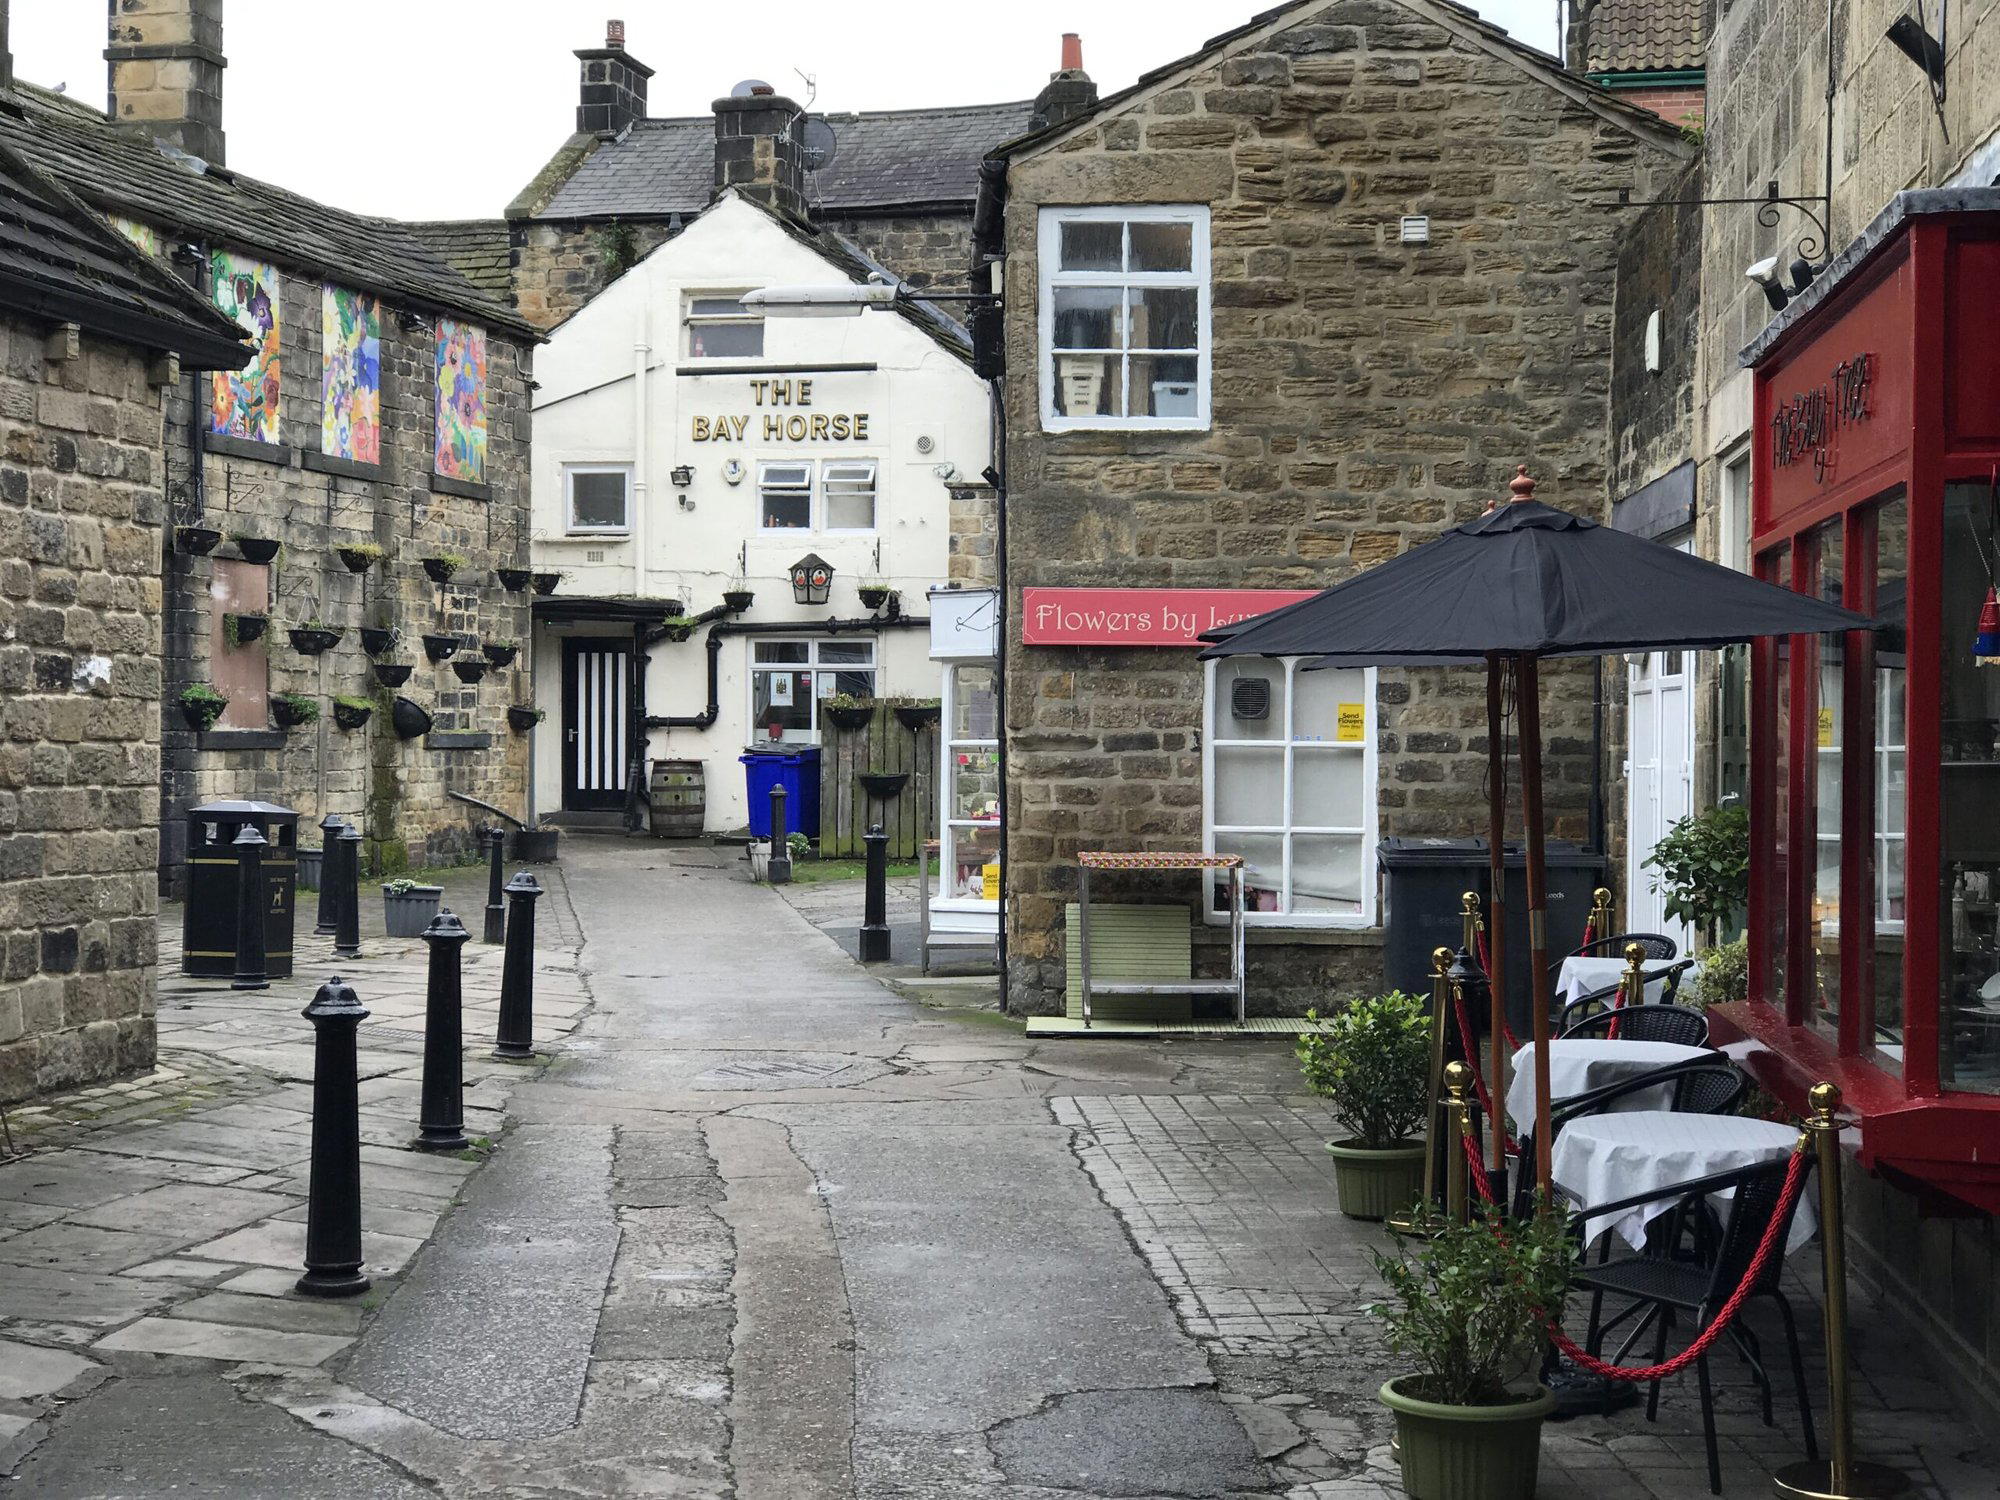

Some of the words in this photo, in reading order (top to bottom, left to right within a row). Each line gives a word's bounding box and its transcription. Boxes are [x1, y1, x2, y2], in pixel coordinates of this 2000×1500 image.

[750, 379, 813, 406] THE
[692, 415, 749, 442] BAY
[763, 413, 869, 442] HORSE
[1035, 603, 1152, 634] Flowers
[1162, 605, 1197, 638] by
